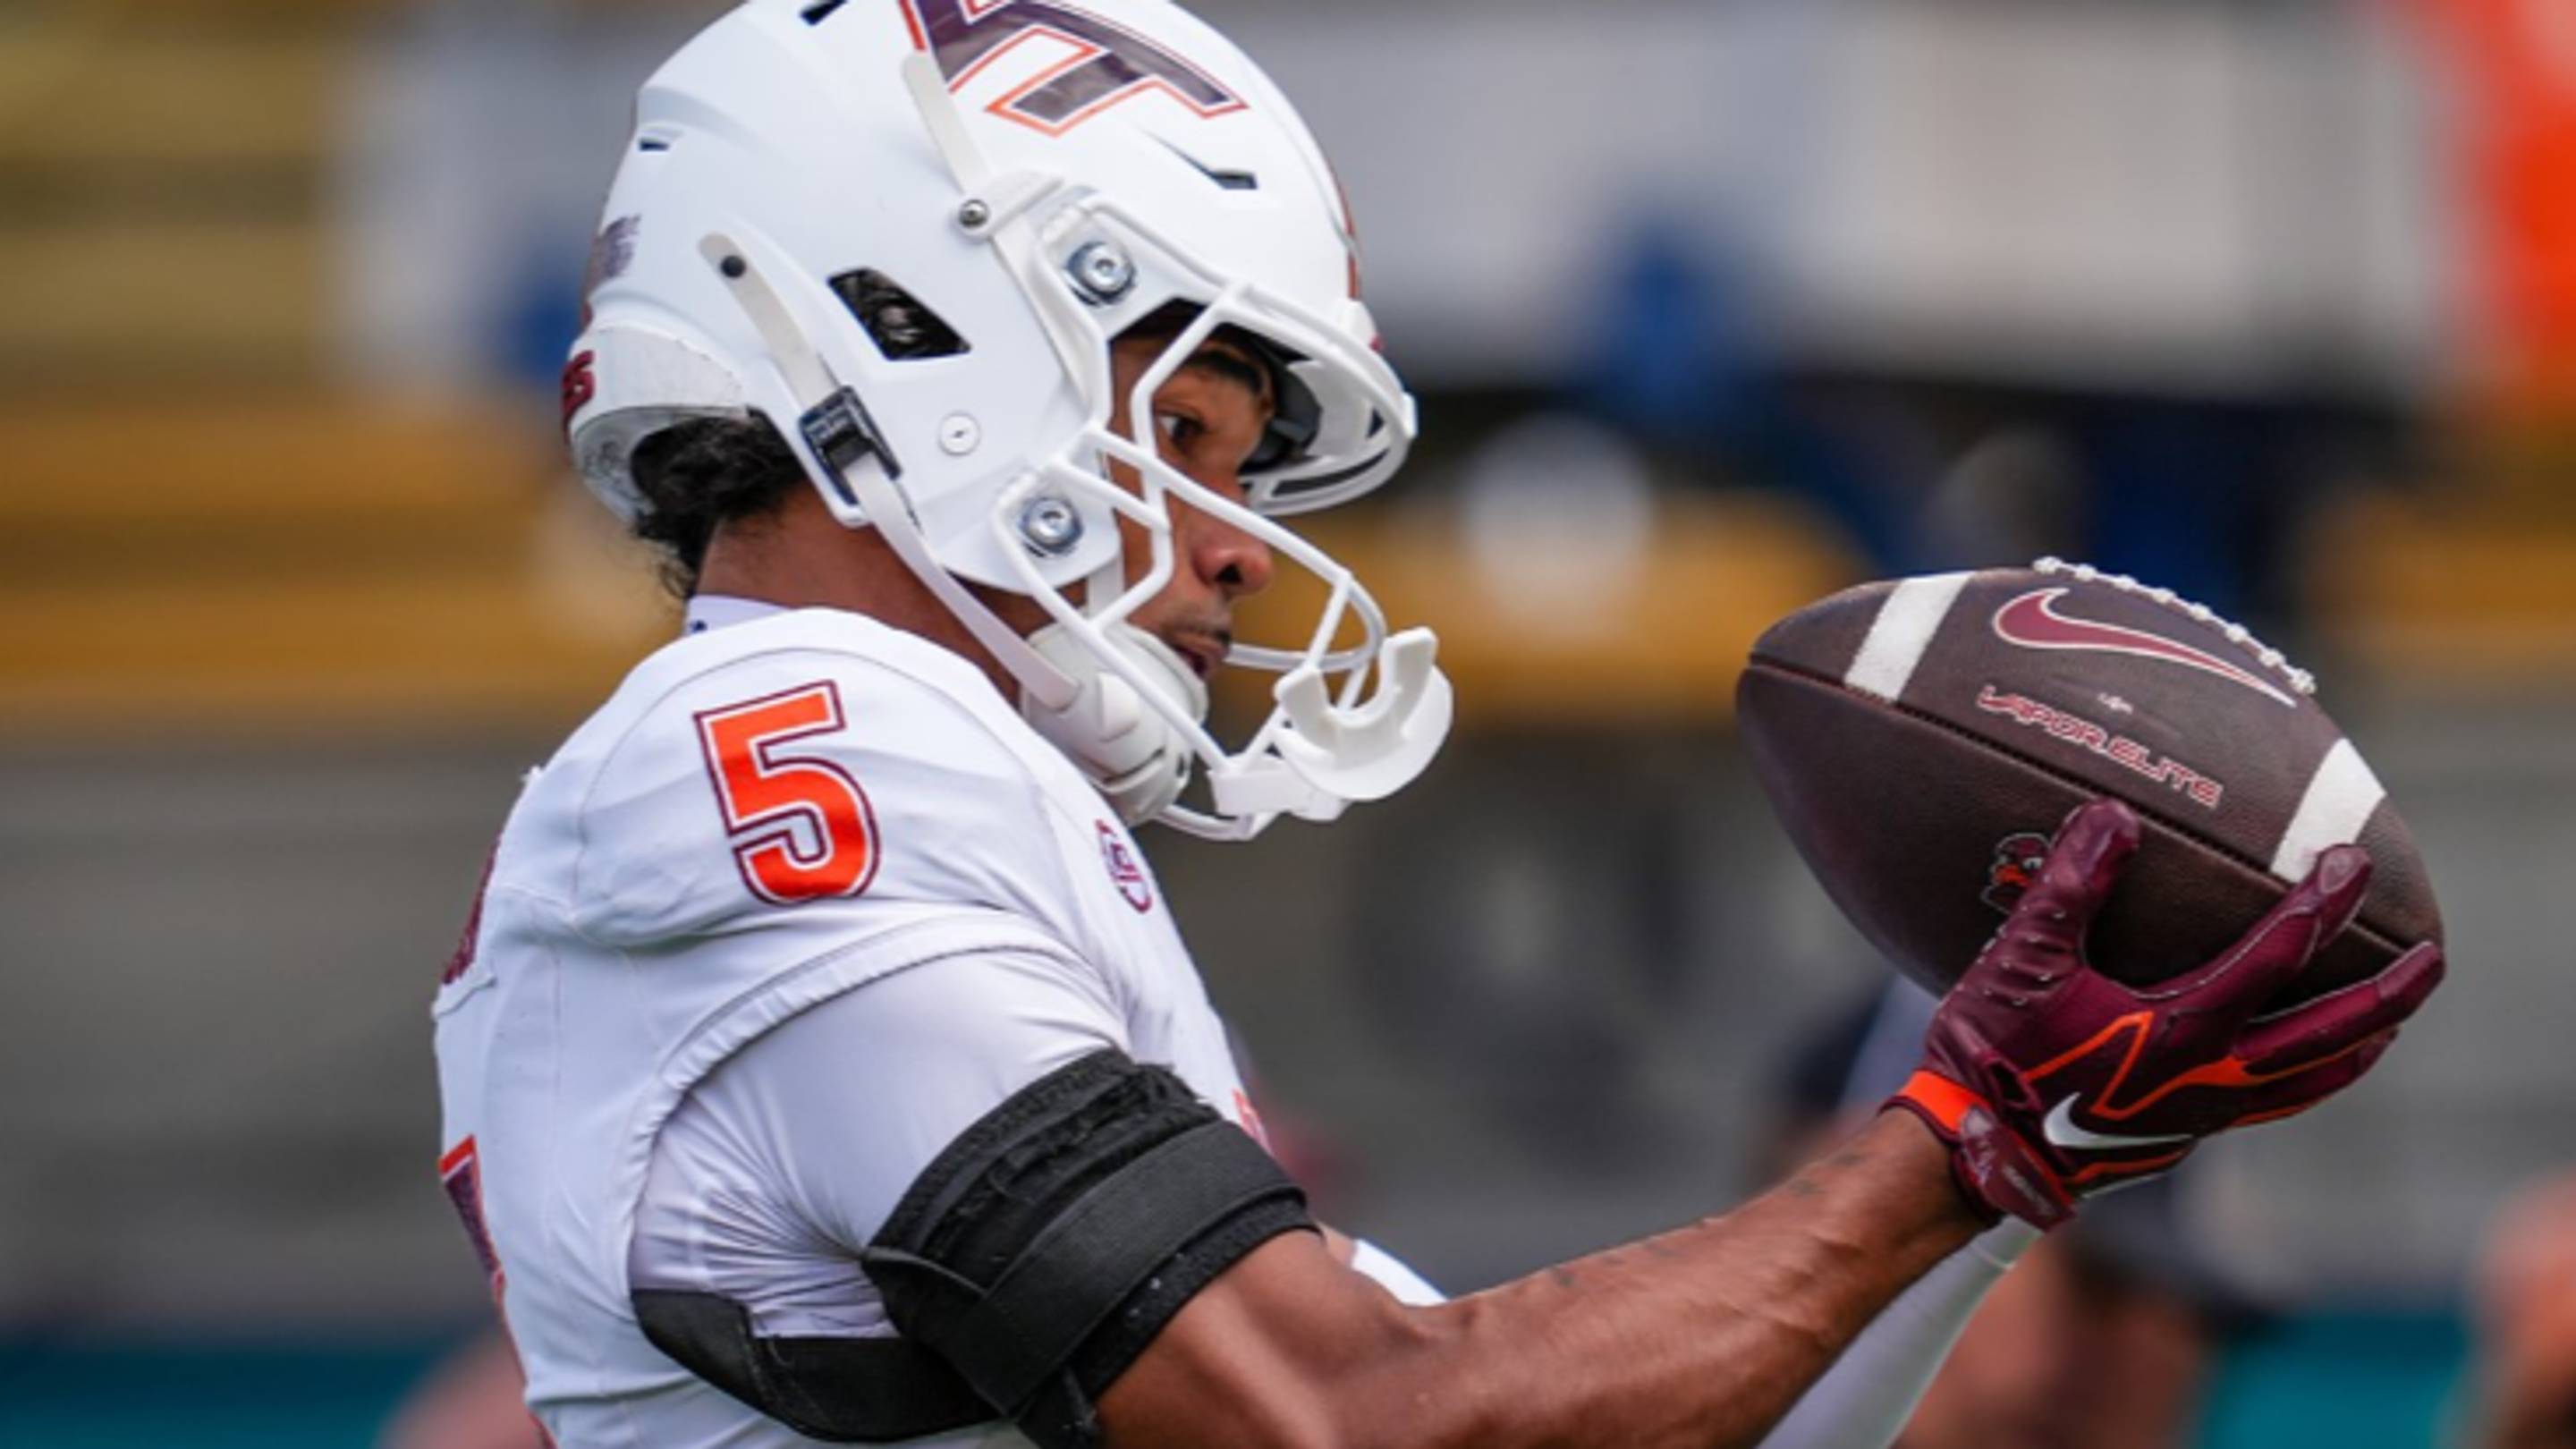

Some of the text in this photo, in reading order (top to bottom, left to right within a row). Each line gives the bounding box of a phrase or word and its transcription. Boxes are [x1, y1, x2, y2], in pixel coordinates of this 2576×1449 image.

[692, 679, 882, 907] 5
[1976, 683, 2224, 809] VAPOR ELITE
